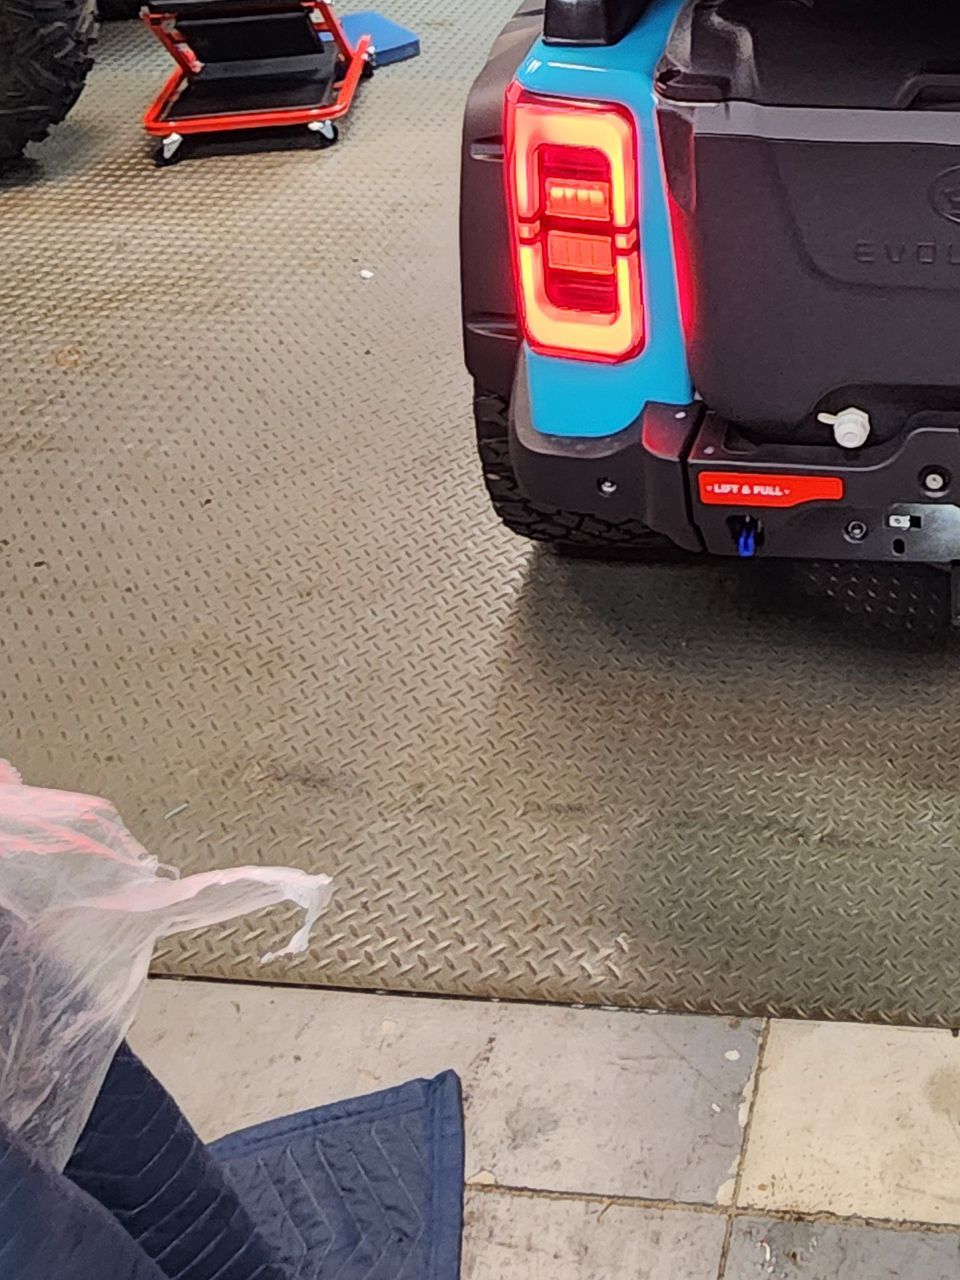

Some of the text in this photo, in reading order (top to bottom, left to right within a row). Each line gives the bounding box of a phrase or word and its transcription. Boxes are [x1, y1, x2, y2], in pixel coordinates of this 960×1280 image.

[713, 483, 784, 496] LIFT & PULL
